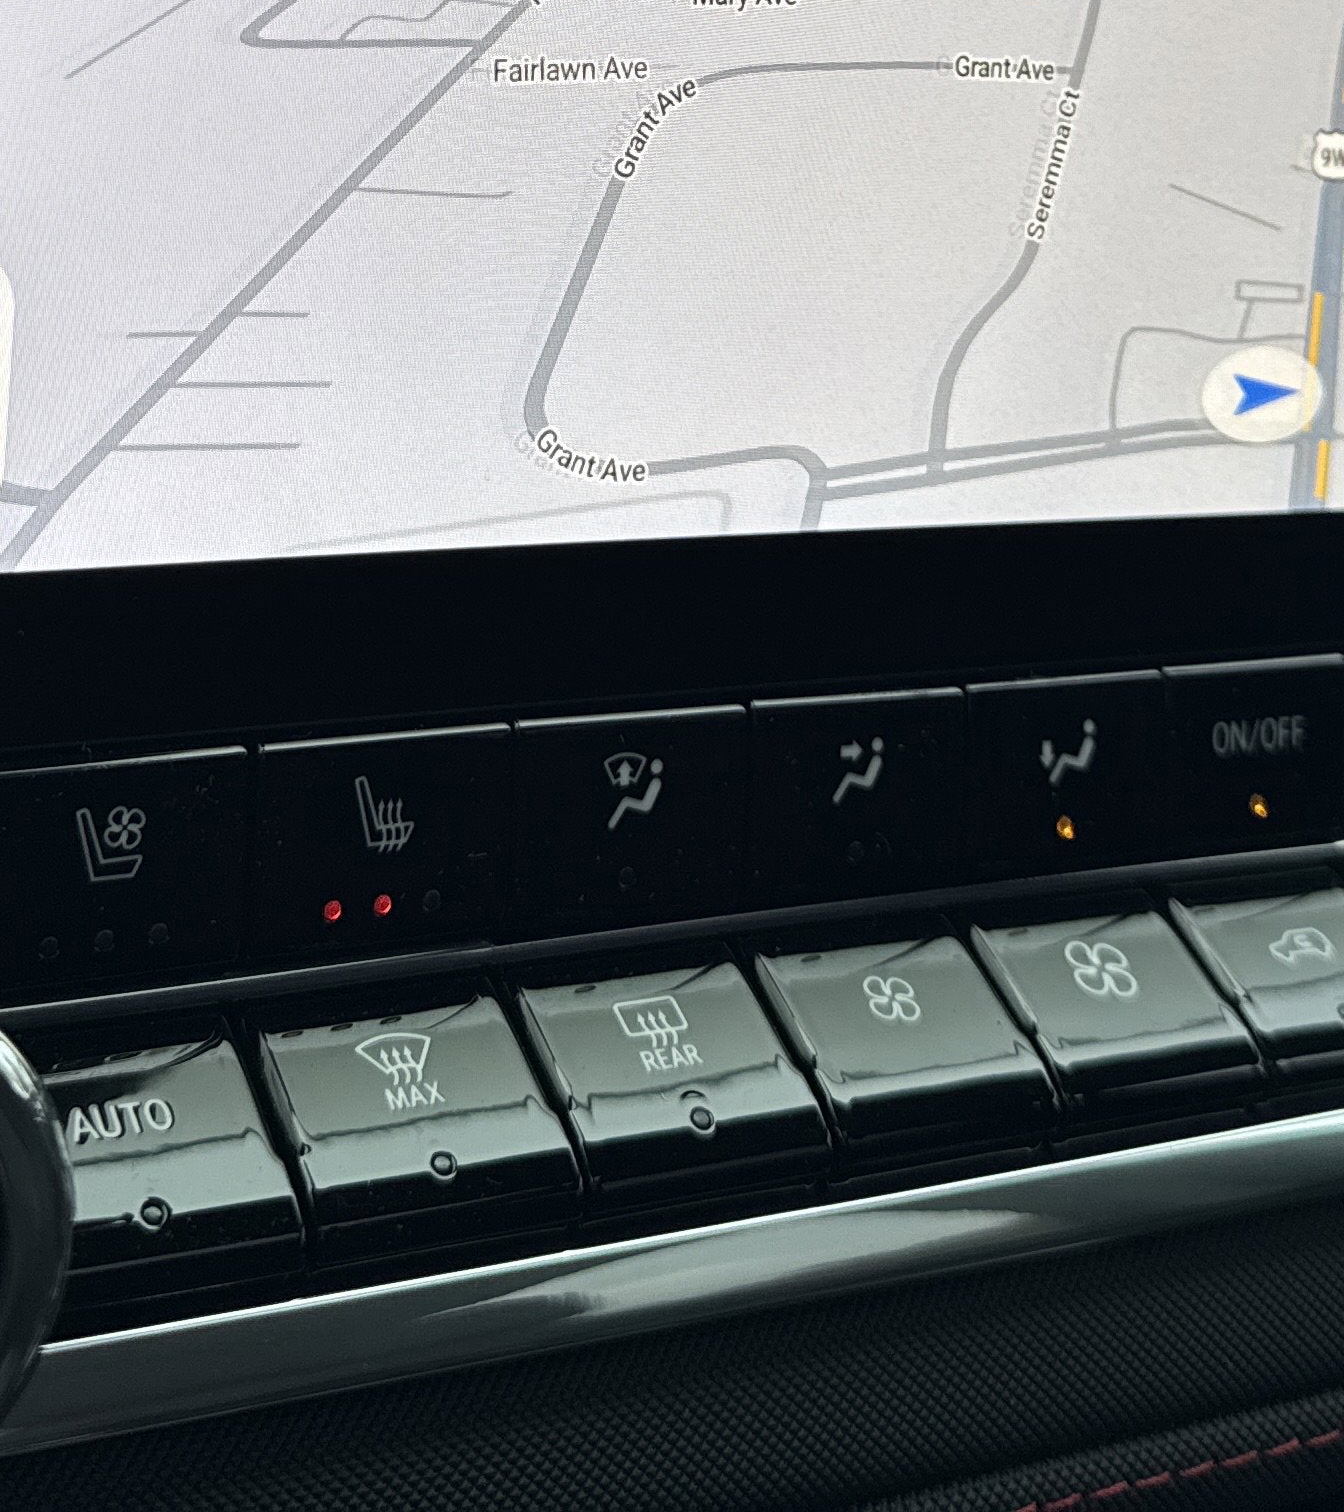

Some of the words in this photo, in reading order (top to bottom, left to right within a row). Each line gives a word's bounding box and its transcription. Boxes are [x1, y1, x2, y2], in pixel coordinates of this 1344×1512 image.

[493, 55, 596, 83] Fairlawn
[603, 55, 649, 81] Ave
[955, 54, 1012, 79] Grant
[1015, 57, 1055, 82] Ave
[614, 107, 661, 179] Grant
[656, 79, 697, 117] Ave
[1026, 112, 1073, 240] Seremma
[1058, 90, 1081, 120] Ct
[536, 428, 598, 478] Grant
[600, 456, 647, 483] Ave
[1212, 714, 1305, 754] ON/OFF
[639, 1043, 704, 1073] REAR
[384, 1081, 447, 1112] MAX
[67, 1099, 174, 1143] AUTO
